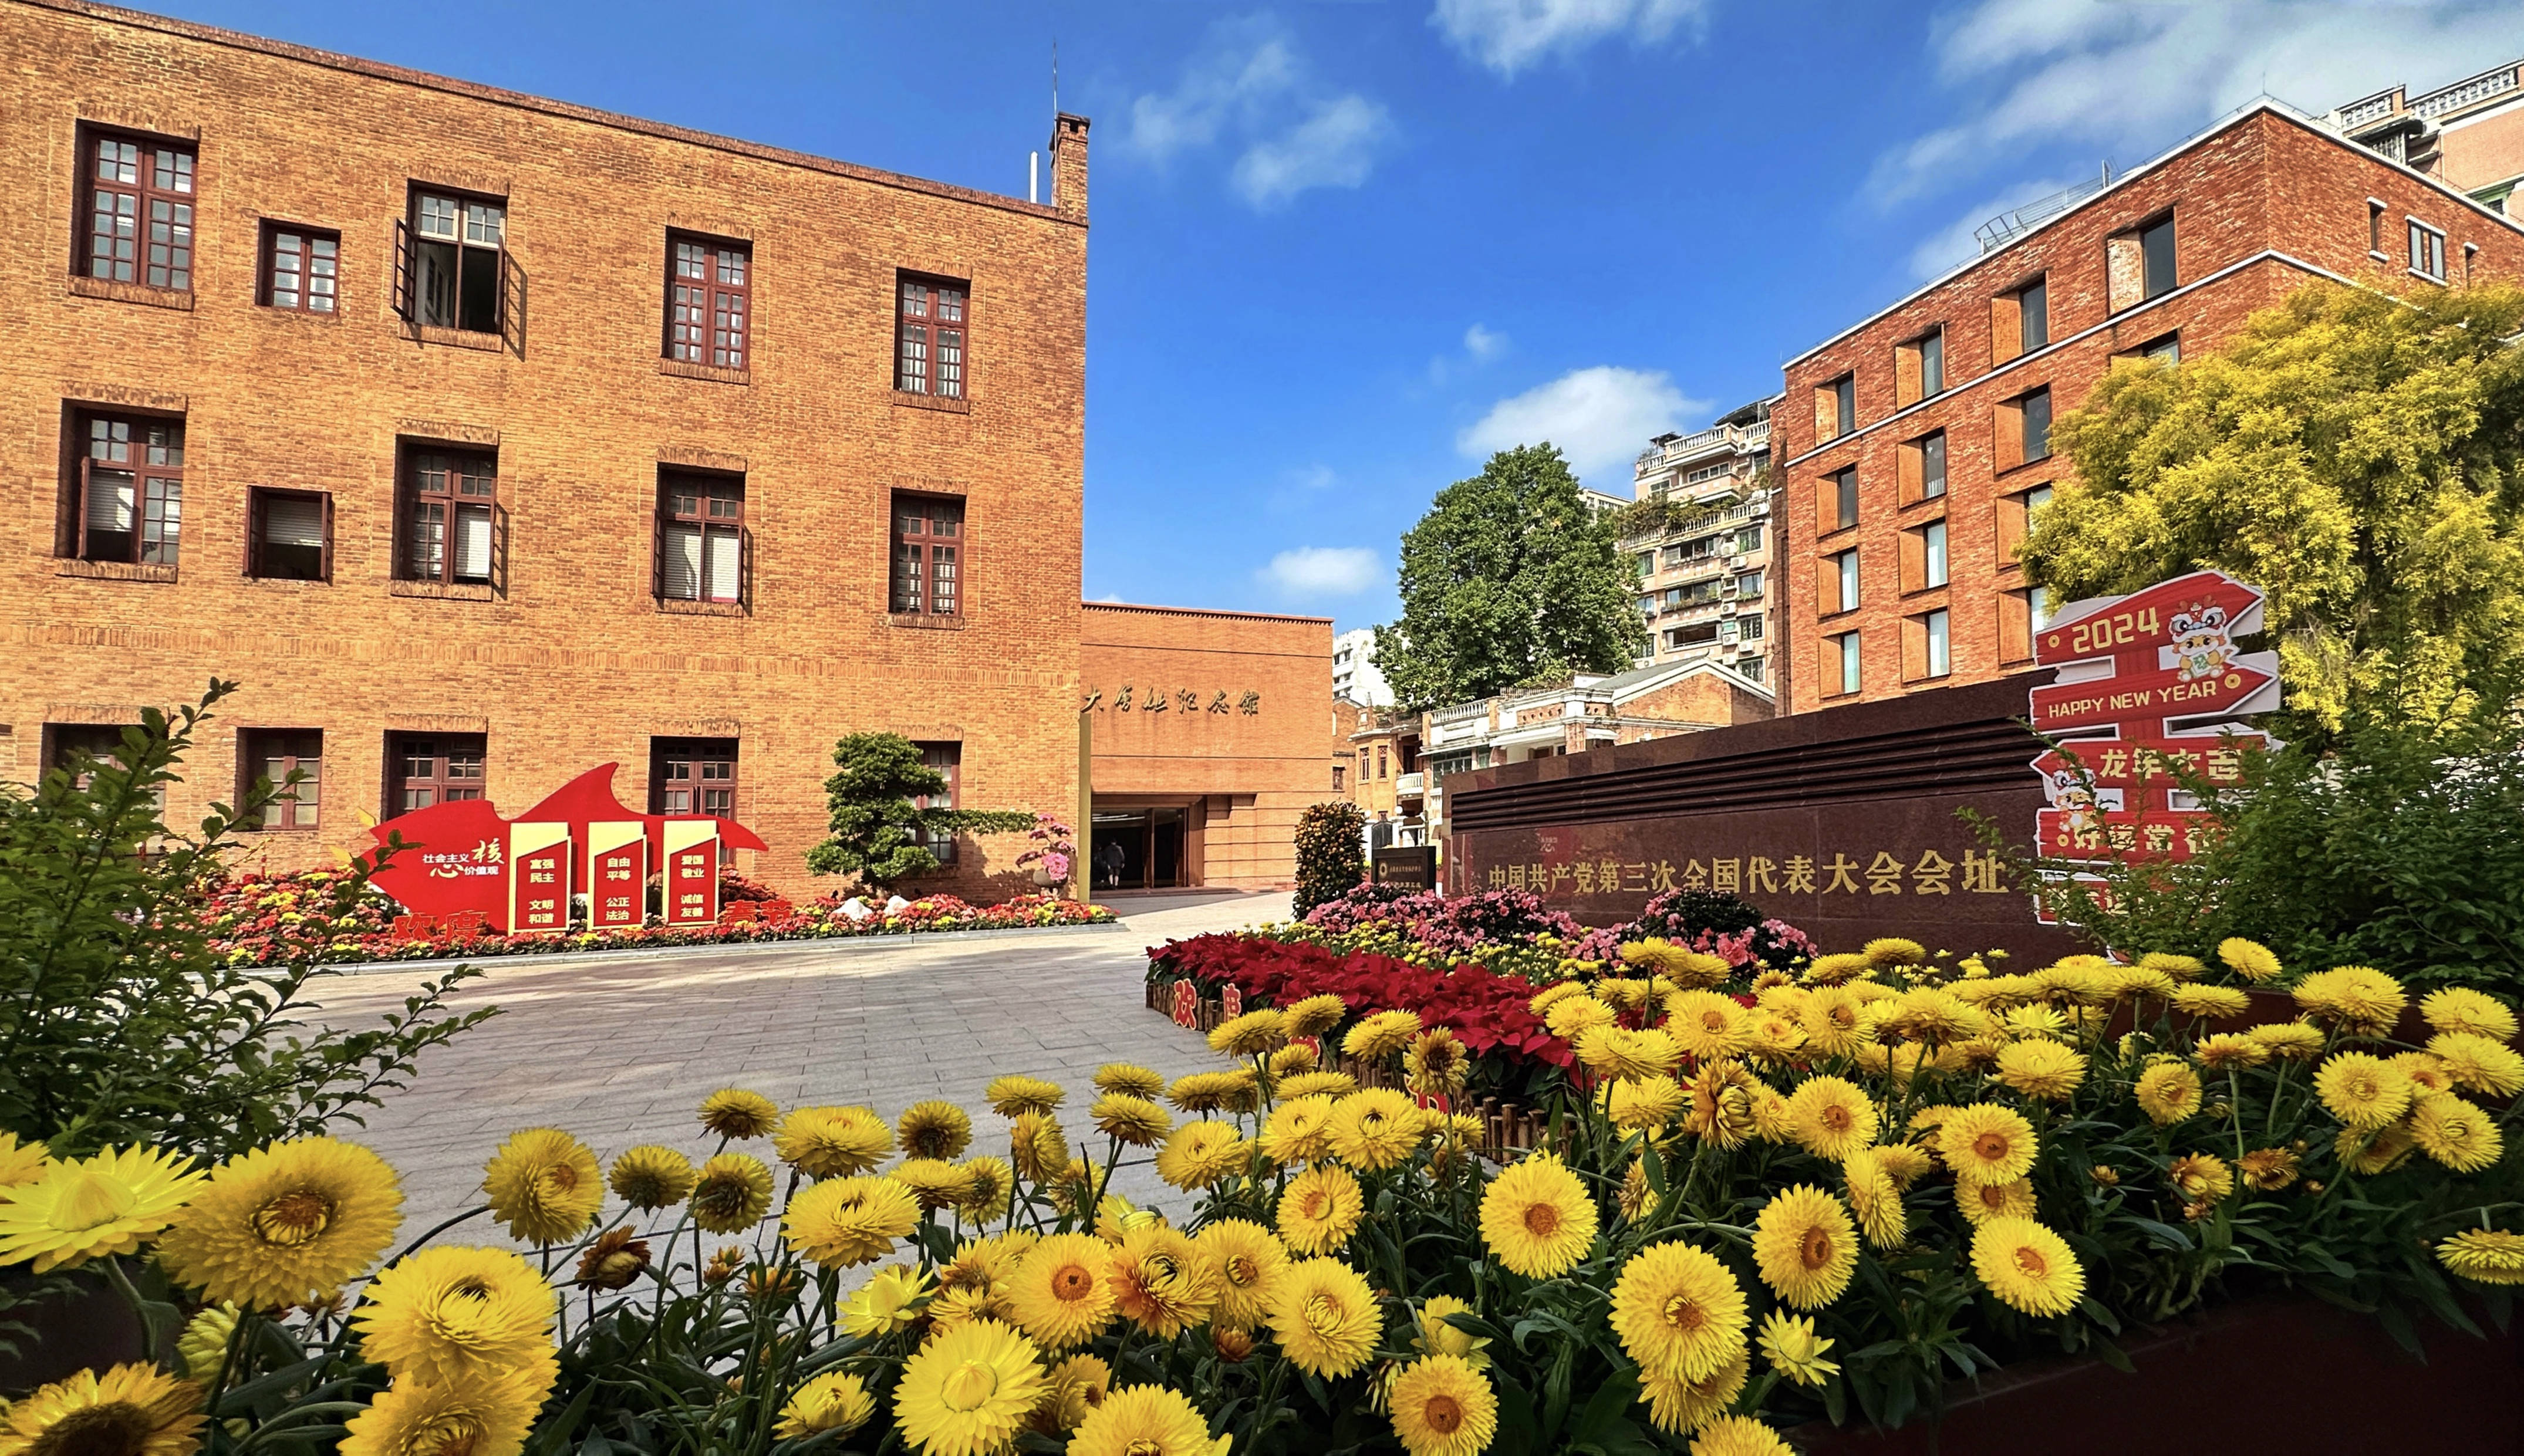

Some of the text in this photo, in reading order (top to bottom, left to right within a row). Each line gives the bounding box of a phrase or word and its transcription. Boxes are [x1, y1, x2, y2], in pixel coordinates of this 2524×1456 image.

[2071, 607, 2159, 653] 2024
[2049, 680, 2216, 718] HAPPY NEW YEAR
[423, 853, 470, 864] 社会主义
[607, 857, 630, 868] 自由
[530, 872, 555, 883] 民主
[606, 870, 631, 881] 平等
[1489, 849, 2010, 896] 中国共产党第三次全国代表大会会址
[606, 897, 630, 907] 公正
[681, 894, 704, 904] 诚信
[529, 900, 554, 910] 文明
[606, 910, 629, 921] 法治
[681, 907, 704, 918] 友善
